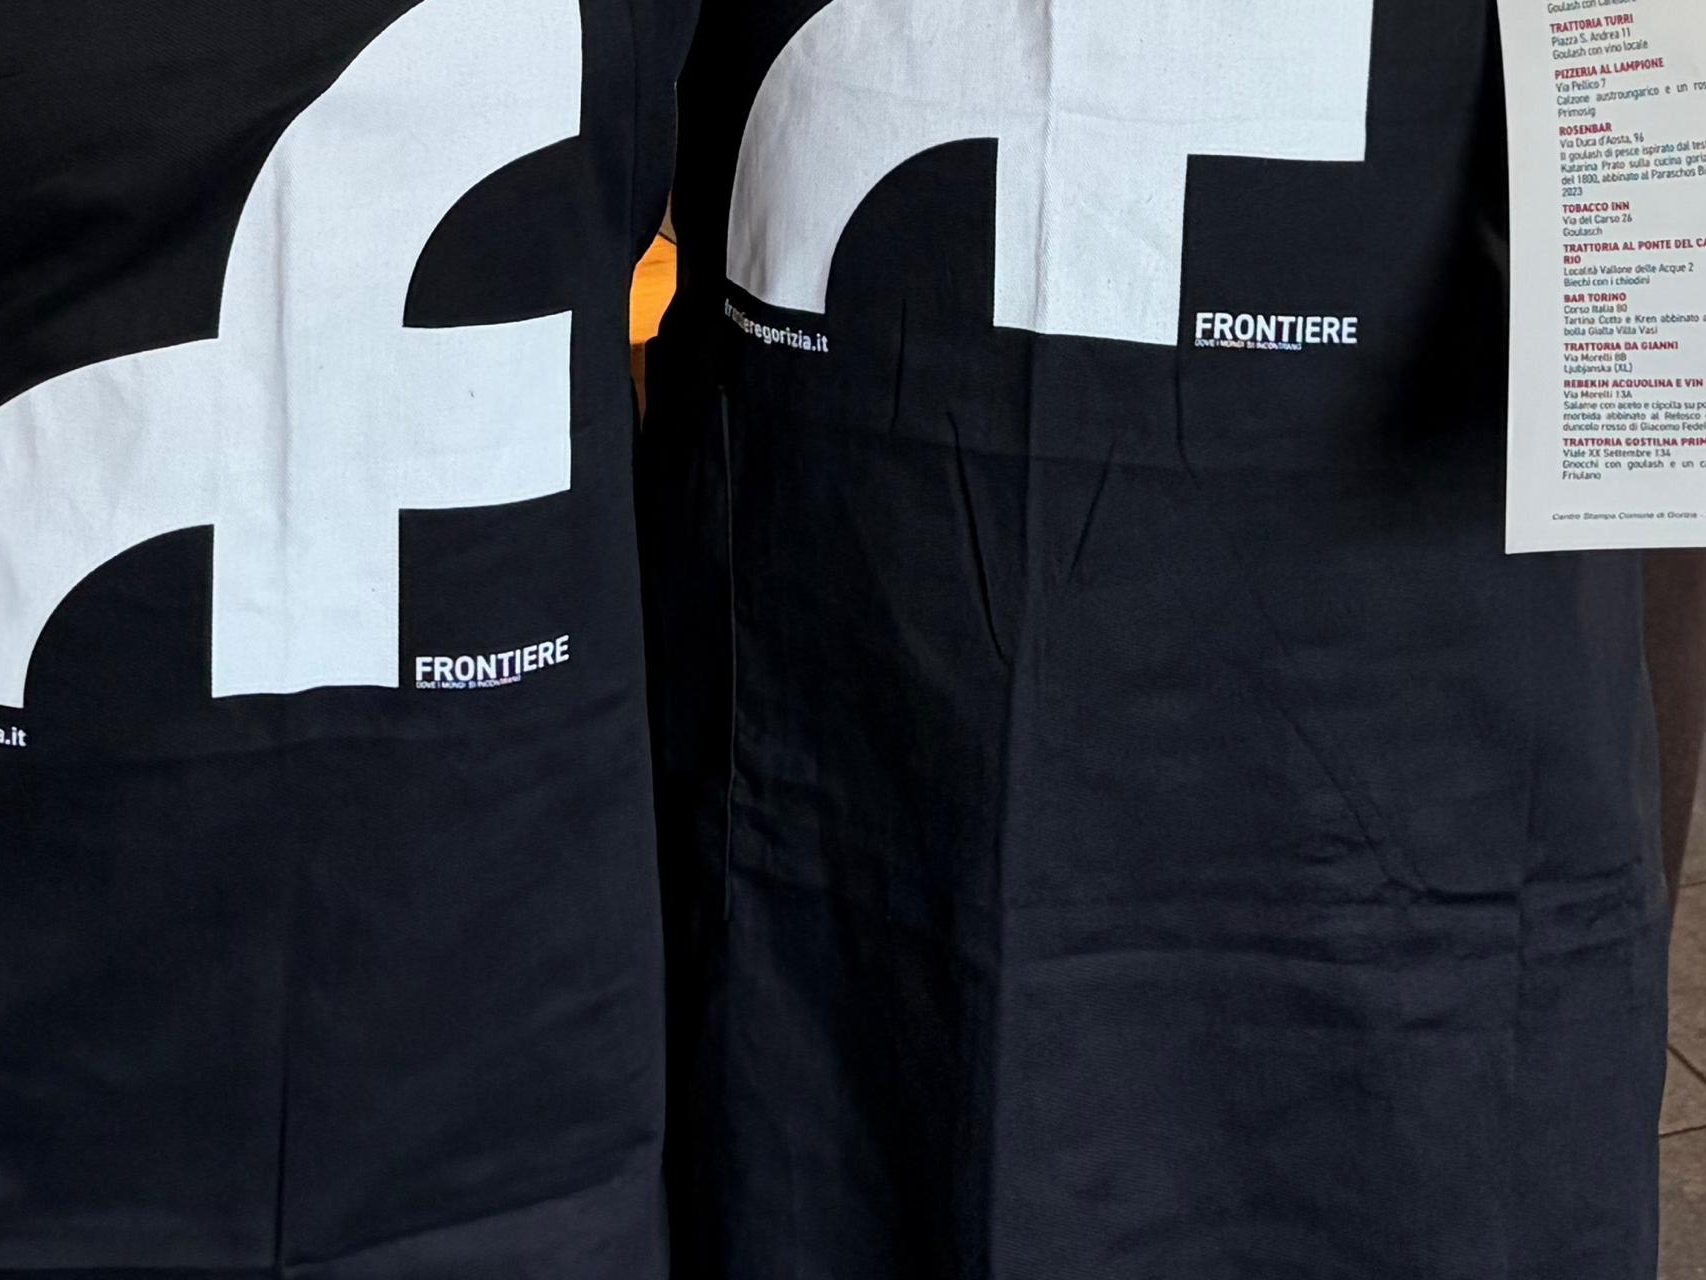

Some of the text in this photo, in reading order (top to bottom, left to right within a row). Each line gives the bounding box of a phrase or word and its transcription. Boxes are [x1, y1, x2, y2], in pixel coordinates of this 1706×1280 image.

[1550, 14, 1633, 33] TRATTORIA TURRI
[1555, 58, 1664, 79] PIZZERIA AL LAMPIONE
[1560, 123, 1612, 136] ROSENBAR
[1563, 202, 1630, 213] TOBACCO INN
[1564, 243, 1620, 253] TRATTORIA
[1623, 242, 1635, 251] AL
[1639, 241, 1671, 250] PONTE
[1675, 240, 1694, 249] DEL
[1564, 256, 1581, 264] RIO
[1564, 293, 1626, 303] BAR TORINO
[1195, 312, 1358, 344] FRONTIERE
[1565, 342, 1678, 351] TRATTORIA DA GIANNI
[1676, 379, 1682, 387] E
[1685, 379, 1703, 387] VIN
[1564, 438, 1622, 446] TRATTORIA
[415, 635, 570, 681] FRONTIERE
